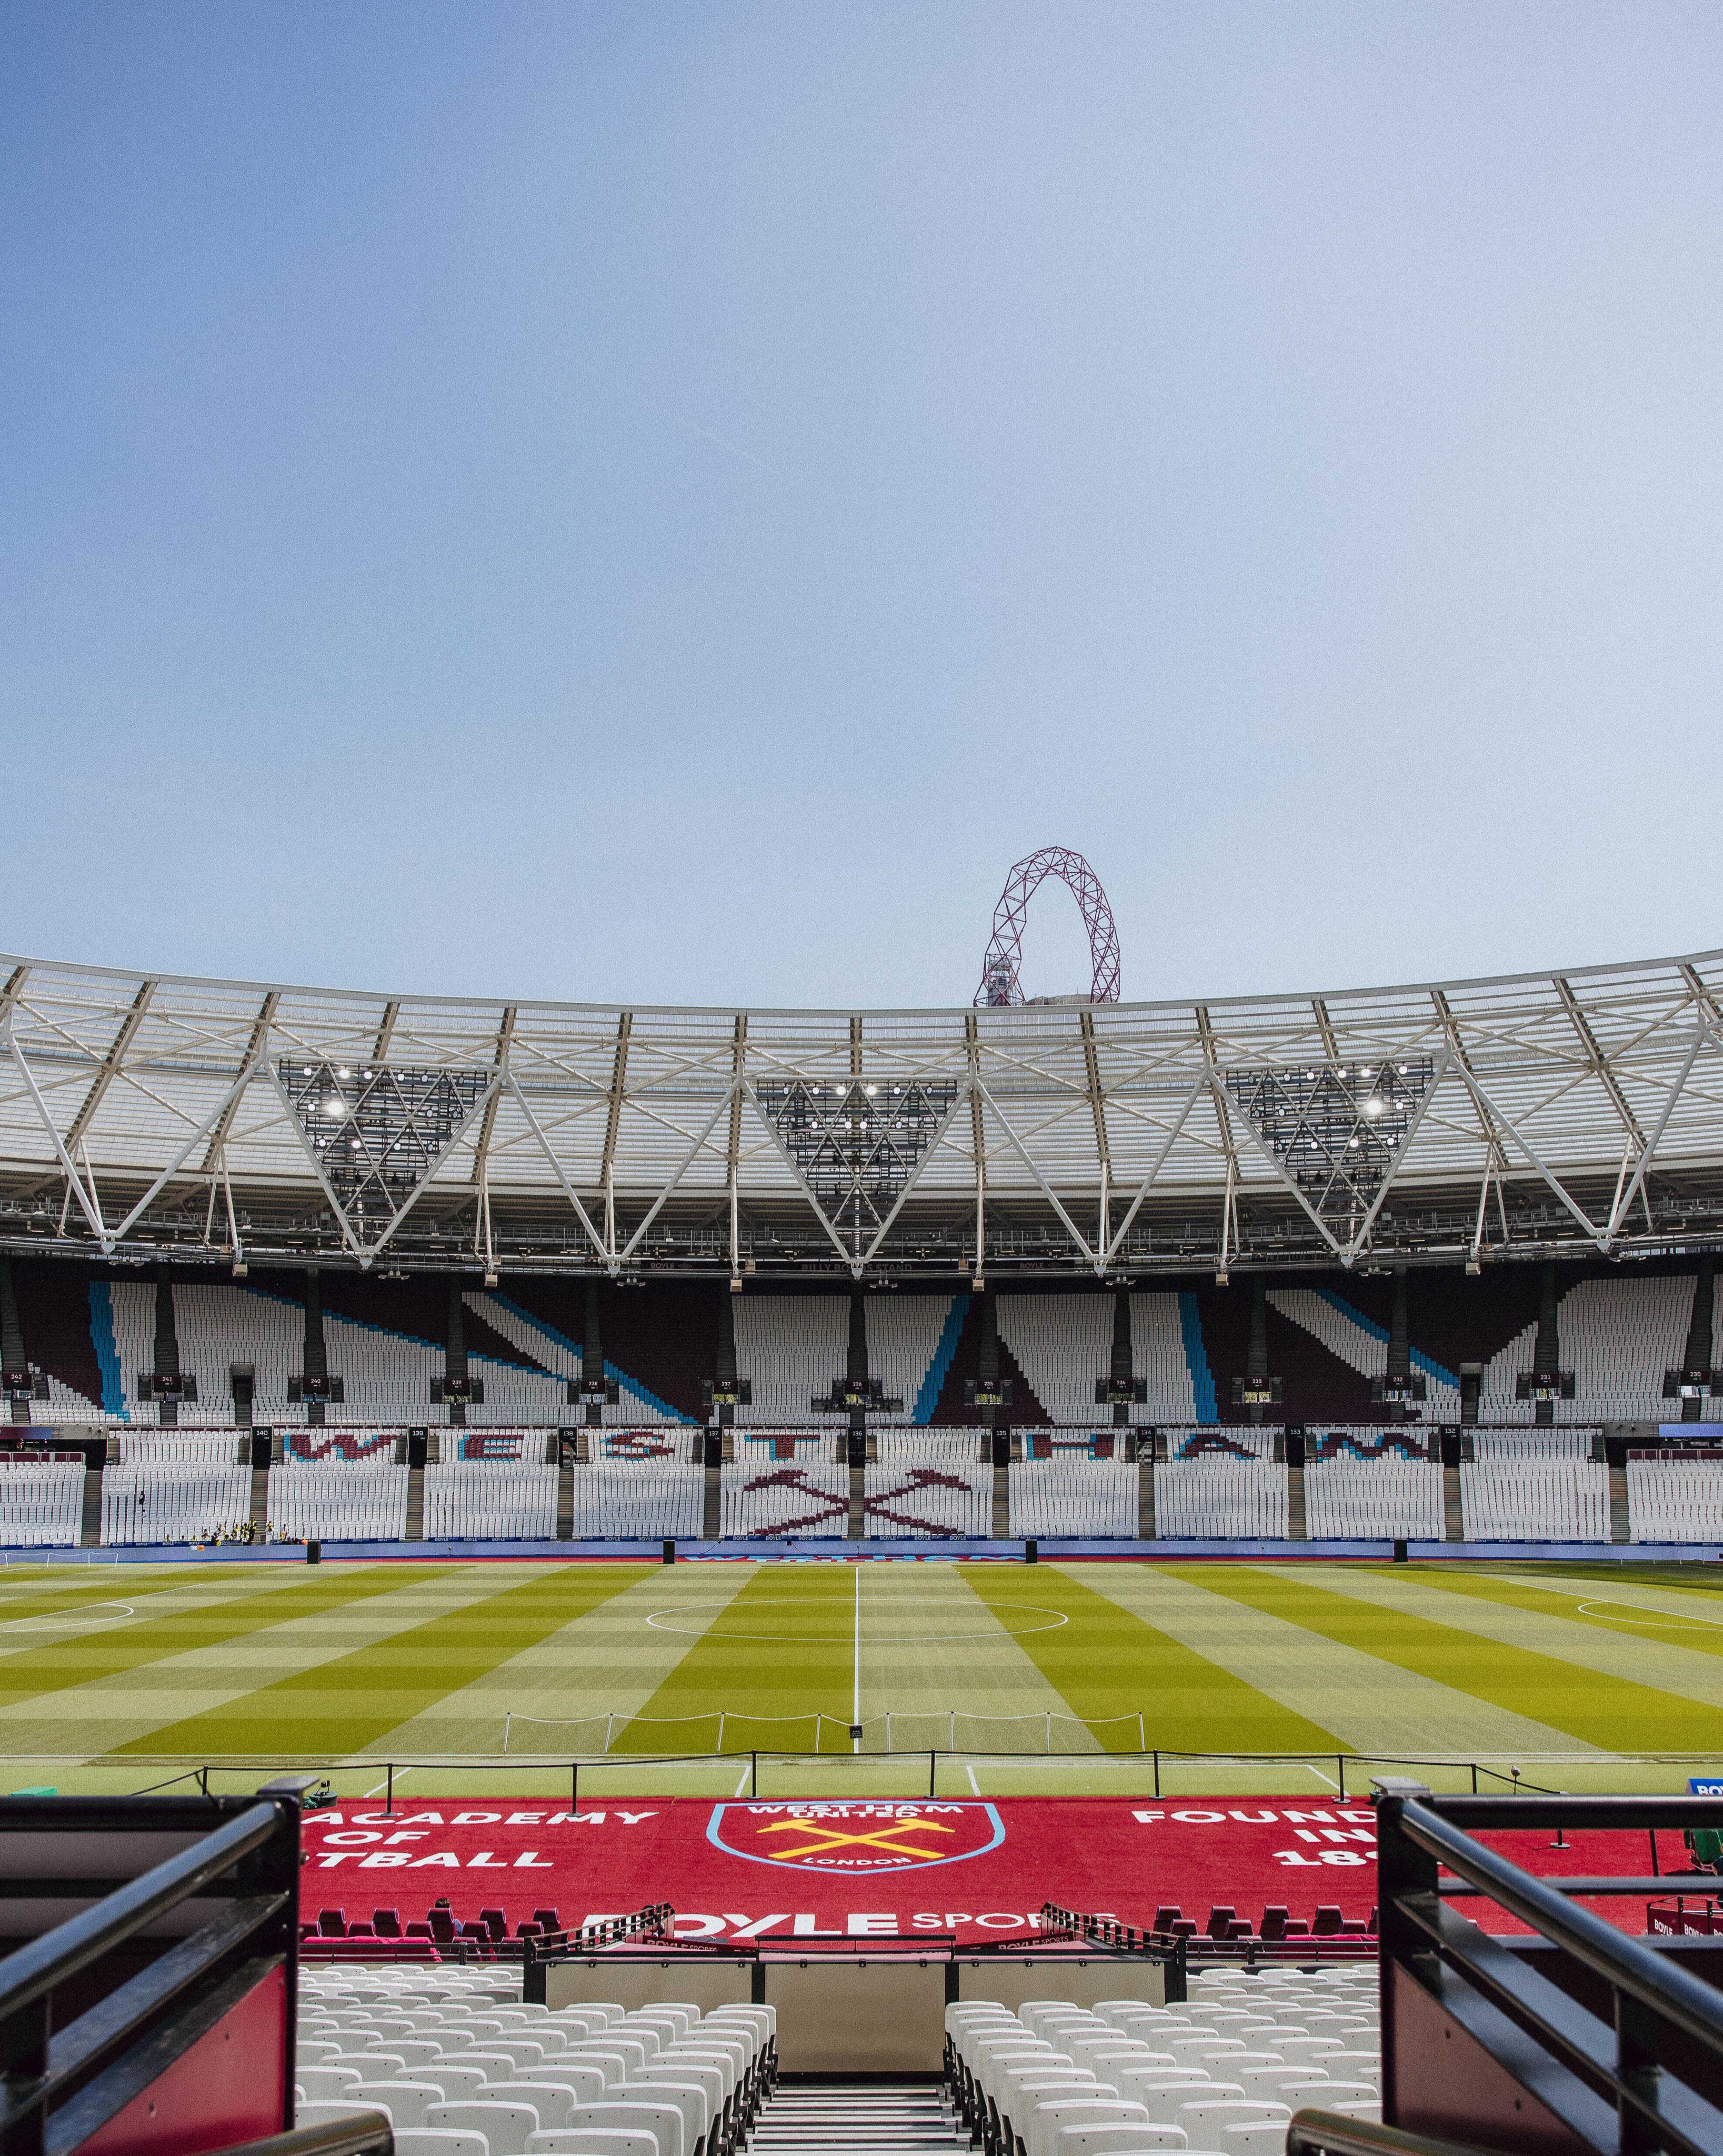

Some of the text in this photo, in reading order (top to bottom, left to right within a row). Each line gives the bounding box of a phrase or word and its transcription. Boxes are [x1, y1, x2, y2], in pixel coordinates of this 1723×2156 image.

[1697, 1785, 1723, 1795] BO
[300, 1812, 659, 1824] ACADEMY
[323, 1831, 430, 1844] OF
[1293, 1829, 1377, 1842] IN
[305, 1852, 554, 1867] TBALL
[912, 1913, 1120, 1929] SPOS
[1684, 1923, 1704, 1937] BOYL
